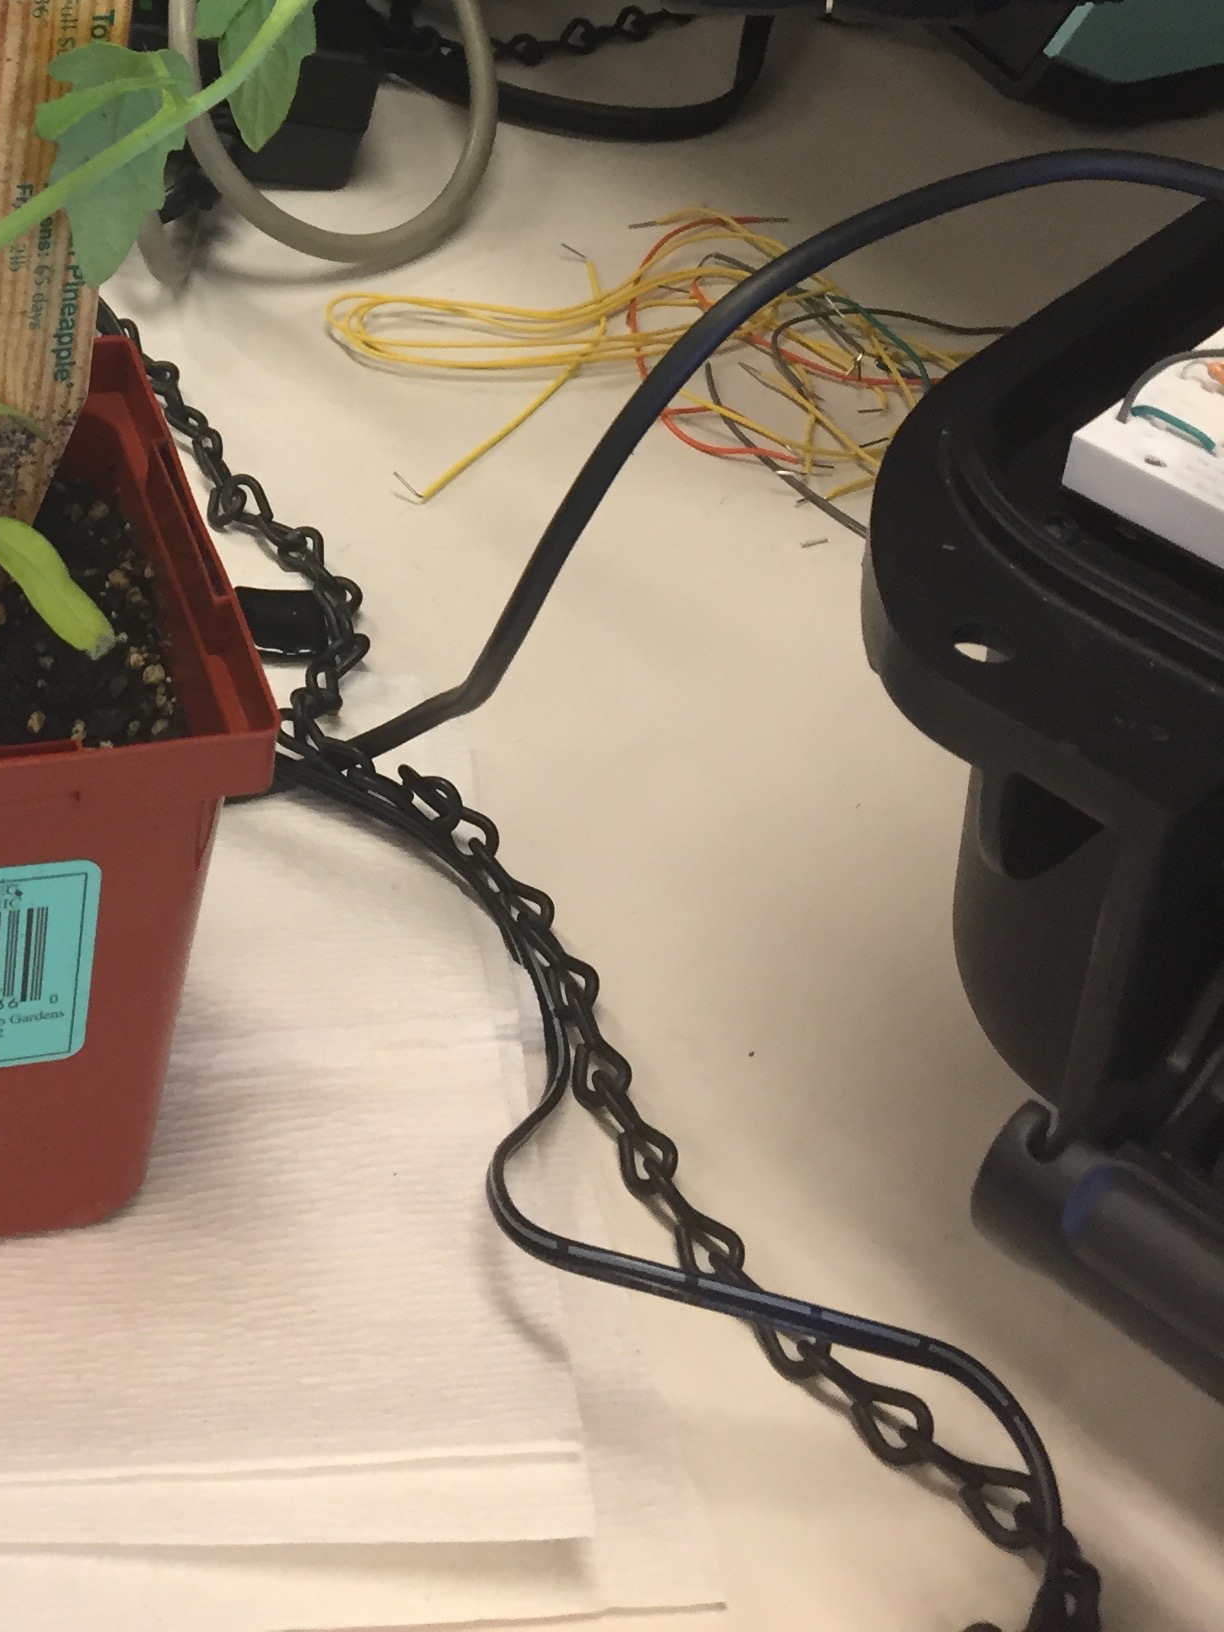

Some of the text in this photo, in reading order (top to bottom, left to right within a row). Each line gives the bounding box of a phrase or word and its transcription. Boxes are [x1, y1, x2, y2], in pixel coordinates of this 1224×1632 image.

[33, 265, 54, 285] 65
[26, 292, 50, 330] days
[9, 1010, 65, 1025] Gardens
